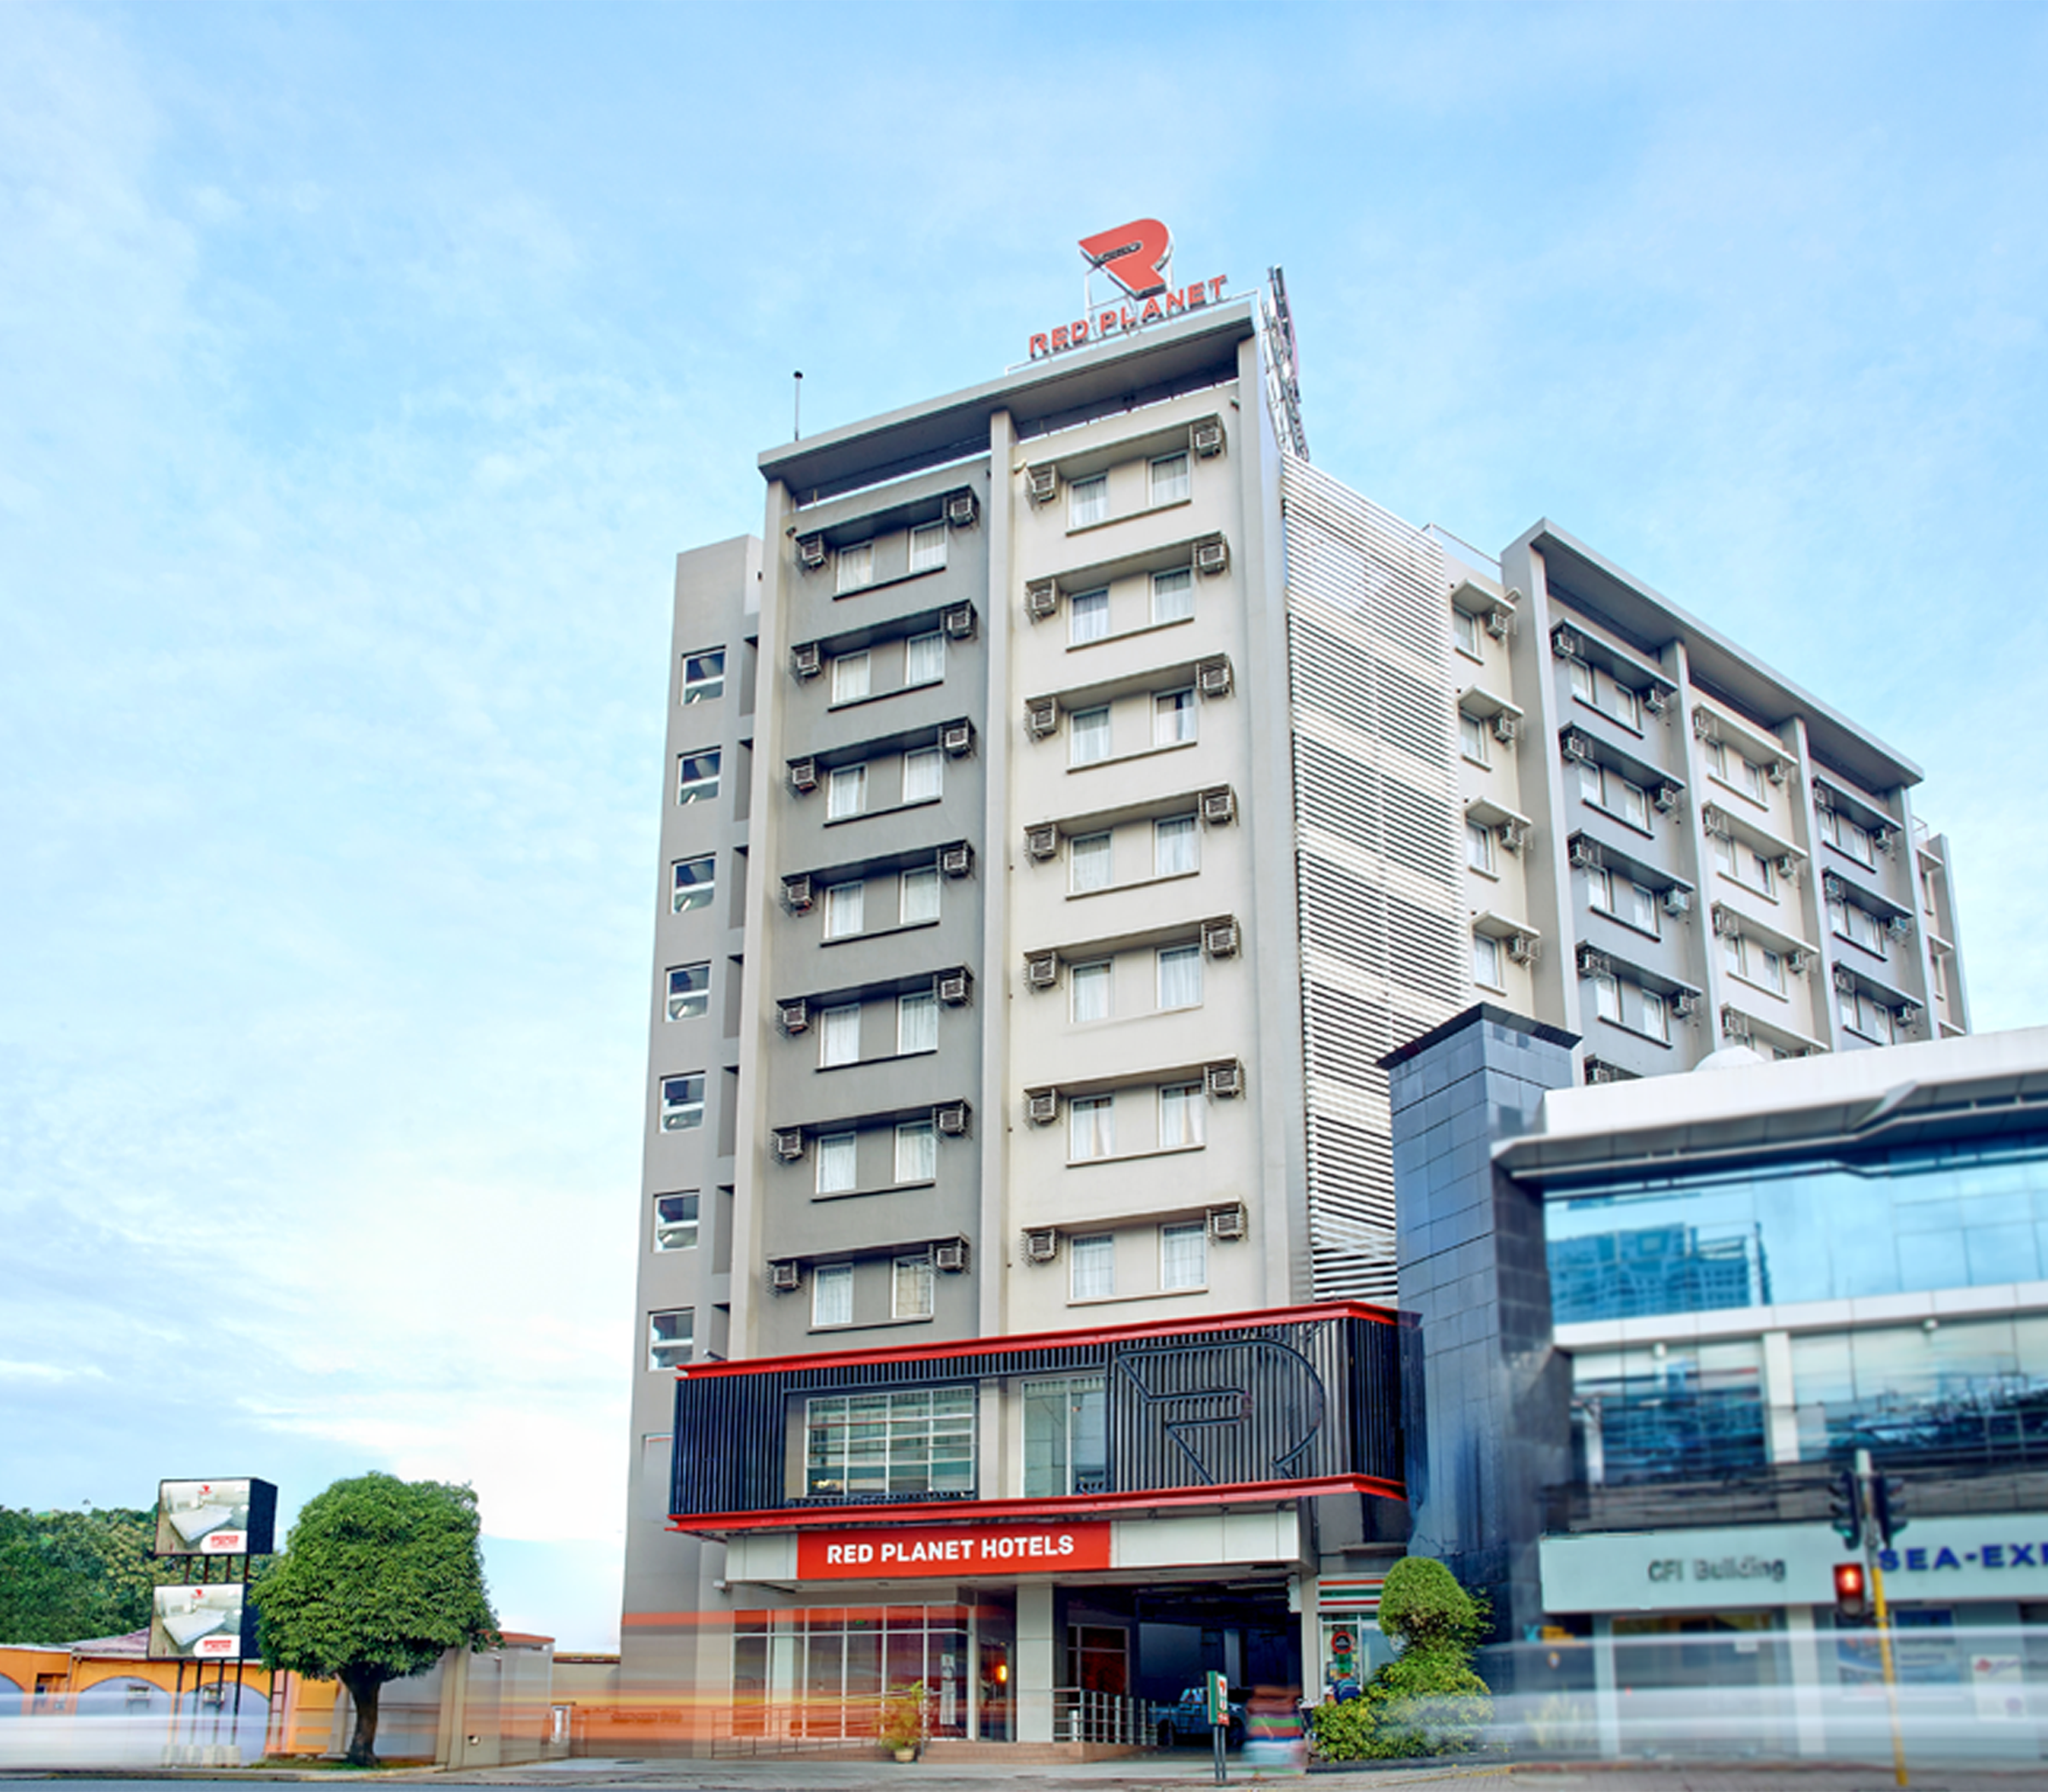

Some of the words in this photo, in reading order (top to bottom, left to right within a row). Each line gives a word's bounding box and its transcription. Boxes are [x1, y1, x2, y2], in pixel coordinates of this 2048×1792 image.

[1028, 319, 1090, 356] RED
[1099, 274, 1228, 334] PLANET
[826, 1544, 875, 1565] RED
[880, 1539, 975, 1563] PLANET
[980, 1534, 1074, 1560] HOTELS
[1647, 1558, 1684, 1582] CFI
[1693, 1555, 1786, 1583] Building
